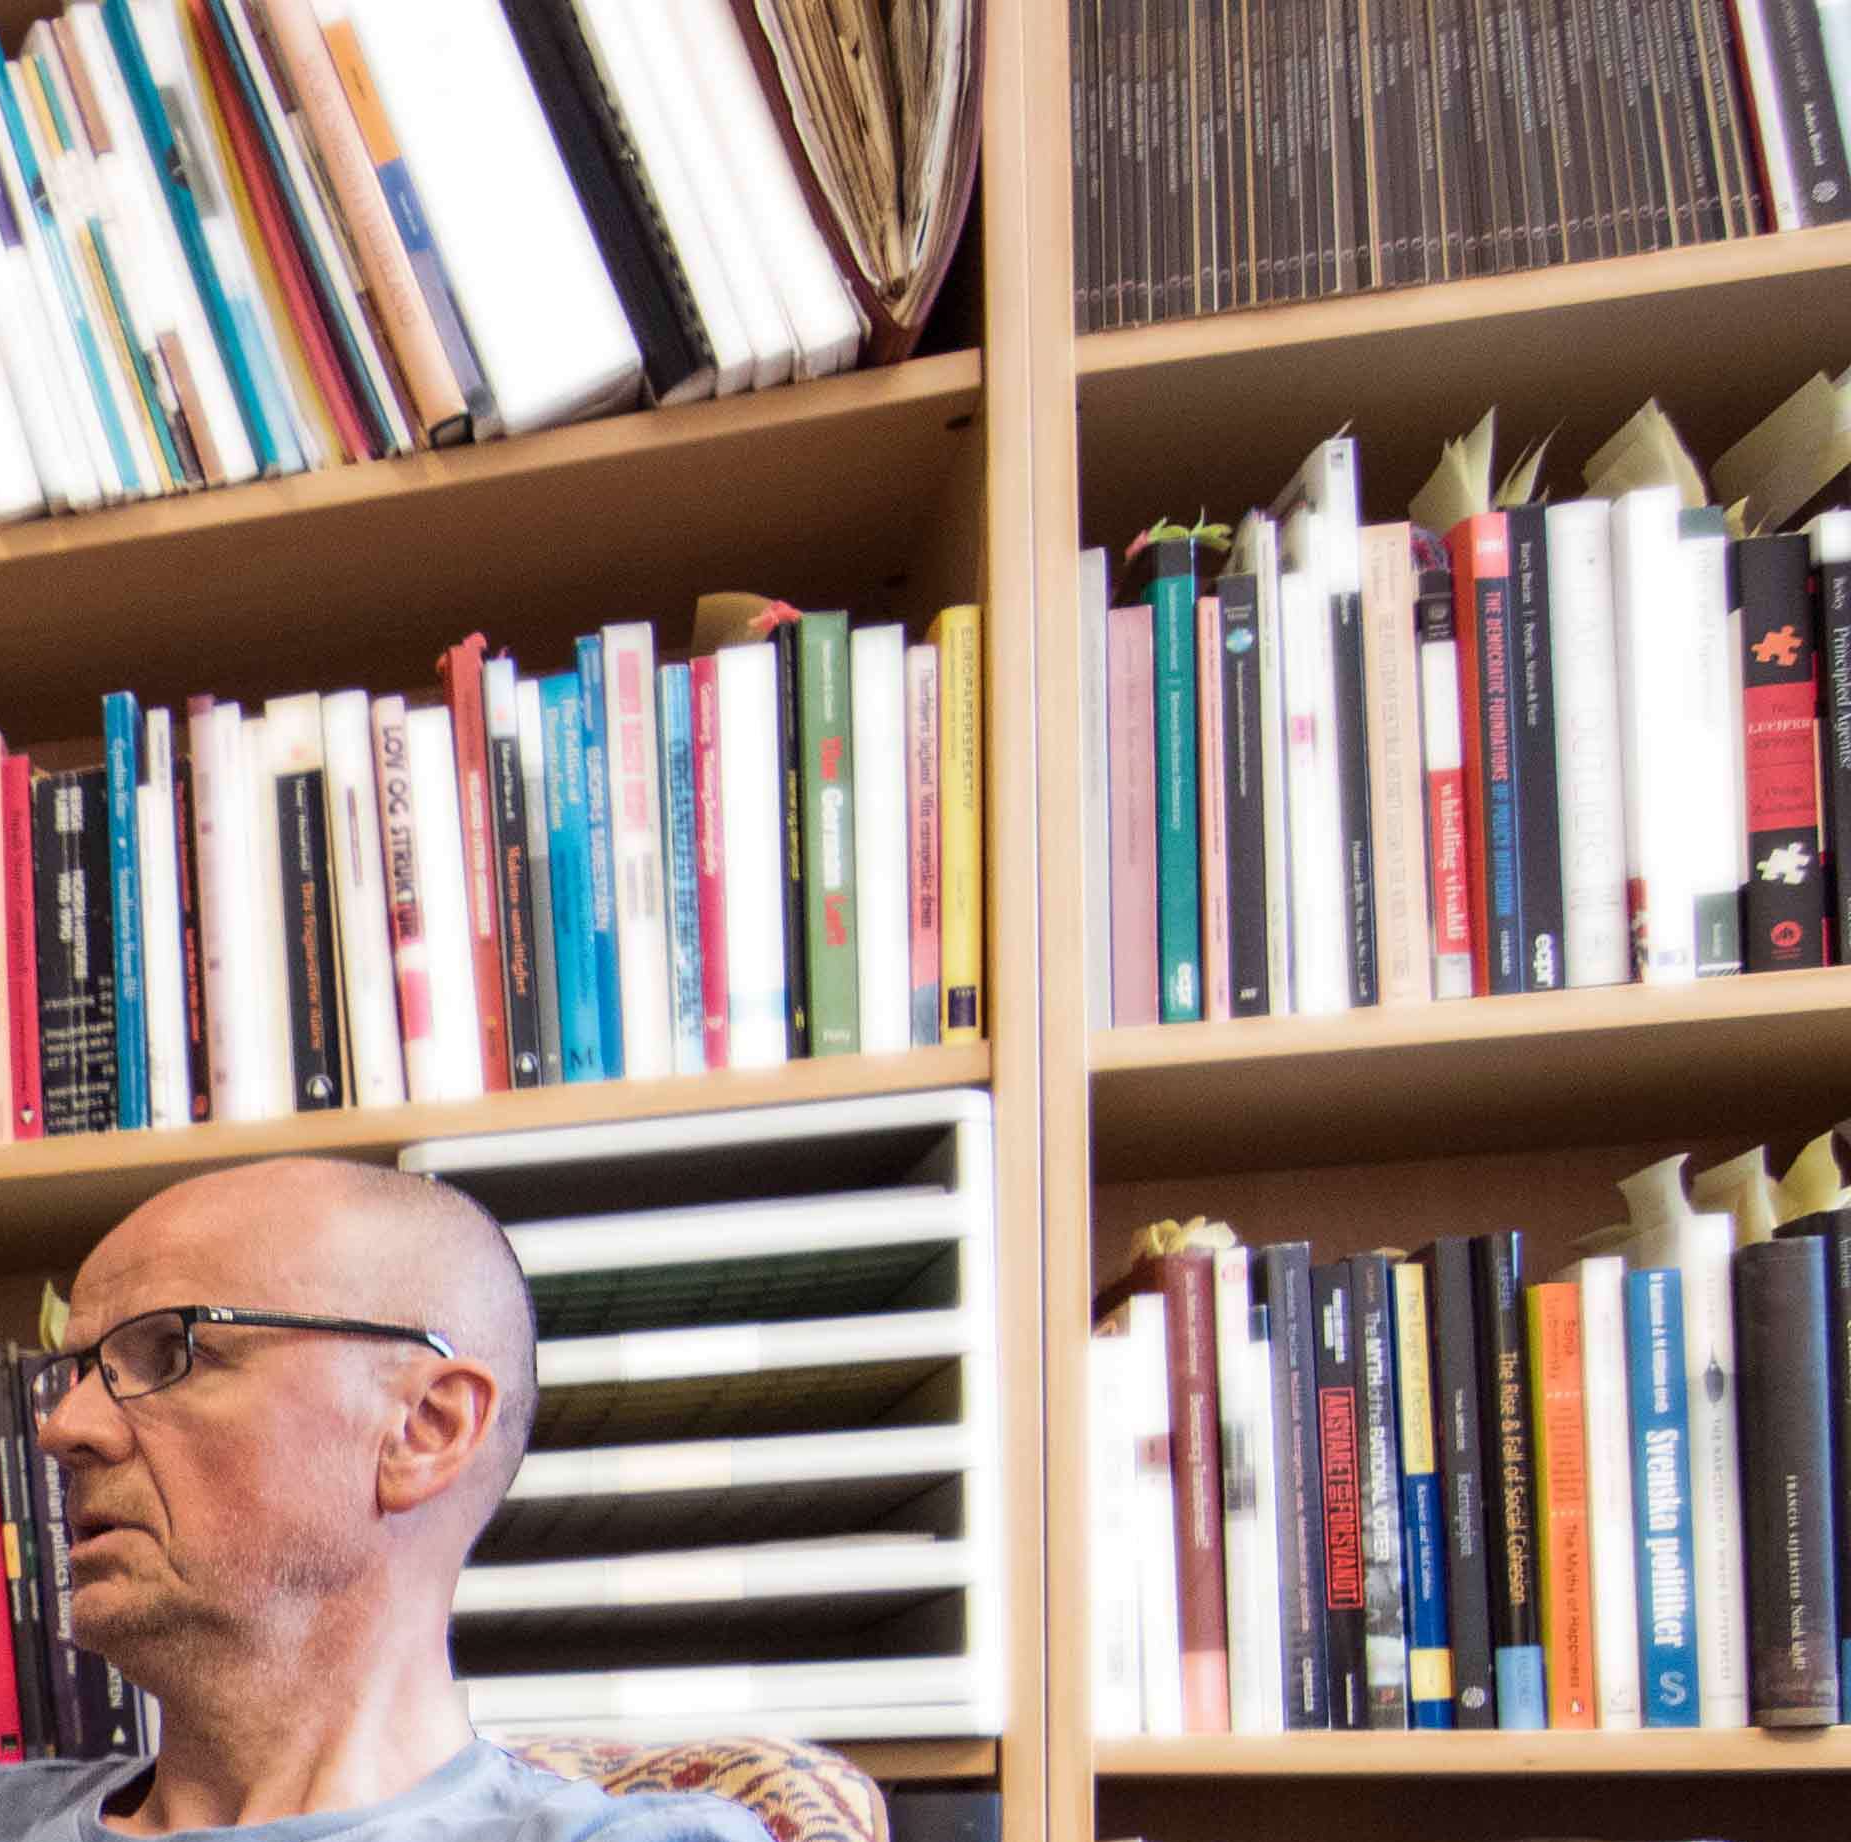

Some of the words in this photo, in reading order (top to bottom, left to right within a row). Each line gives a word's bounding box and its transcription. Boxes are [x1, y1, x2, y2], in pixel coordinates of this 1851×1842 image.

[1484, 591, 1502, 614] THE
[1831, 576, 1846, 610] Besley
[1485, 618, 1505, 694] DEMOCRATIC
[1830, 626, 1850, 710] Principled
[960, 626, 974, 812] EUROPAPERSPEKTIV
[1489, 698, 1508, 781] FOUNDATIONS
[1834, 710, 1851, 770] Agents?
[382, 725, 407, 771] LOV
[820, 736, 844, 781] The
[70, 786, 84, 831] BERGE
[387, 778, 410, 816] OG
[1492, 784, 1509, 801] OF
[820, 788, 845, 890] German
[1438, 783, 1460, 870] whistling
[390, 826, 419, 941] STRUKTUR
[1445, 875, 1465, 941] vivaldi
[824, 895, 848, 947] Left
[1532, 932, 1556, 988] ecpr
[1498, 1257, 1512, 1311] LARSEN
[1365, 1311, 1383, 1336] The
[1559, 1319, 1577, 1358] Sonja
[1365, 1337, 1386, 1385] MYTH
[1499, 1351, 1518, 1380] The
[1368, 1387, 1386, 1402] of
[1368, 1402, 1387, 1426] the
[1500, 1384, 1520, 1416] Rise
[1322, 1395, 1351, 1482] ANSVARET
[1501, 1419, 1521, 1433] &
[1502, 1436, 1522, 1463] Fall
[1711, 1417, 1722, 1443] THE
[1369, 1426, 1390, 1505] RATIONAL
[1503, 1467, 1523, 1483] of
[1647, 1428, 1684, 1532] Svenska
[1450, 1472, 1476, 1558] Korrupsjon
[1504, 1487, 1526, 1530] Social
[1785, 1474, 1801, 1528] FRANCIS
[47, 1522, 71, 1587] politics
[1327, 1503, 1356, 1600] FORSVANDT
[1371, 1505, 1391, 1562] VOTER
[1562, 1523, 1578, 1551] The
[1507, 1534, 1528, 1604] Cohesion
[1561, 1554, 1580, 1596] Myths
[1785, 1532, 1803, 1601] SEJERSTED
[53, 1590, 75, 1641] today
[1566, 1598, 1580, 1613] of
[1645, 1538, 1687, 1648] politiker
[1790, 1603, 1807, 1638] Norsk
[1563, 1615, 1583, 1688] Happiness
